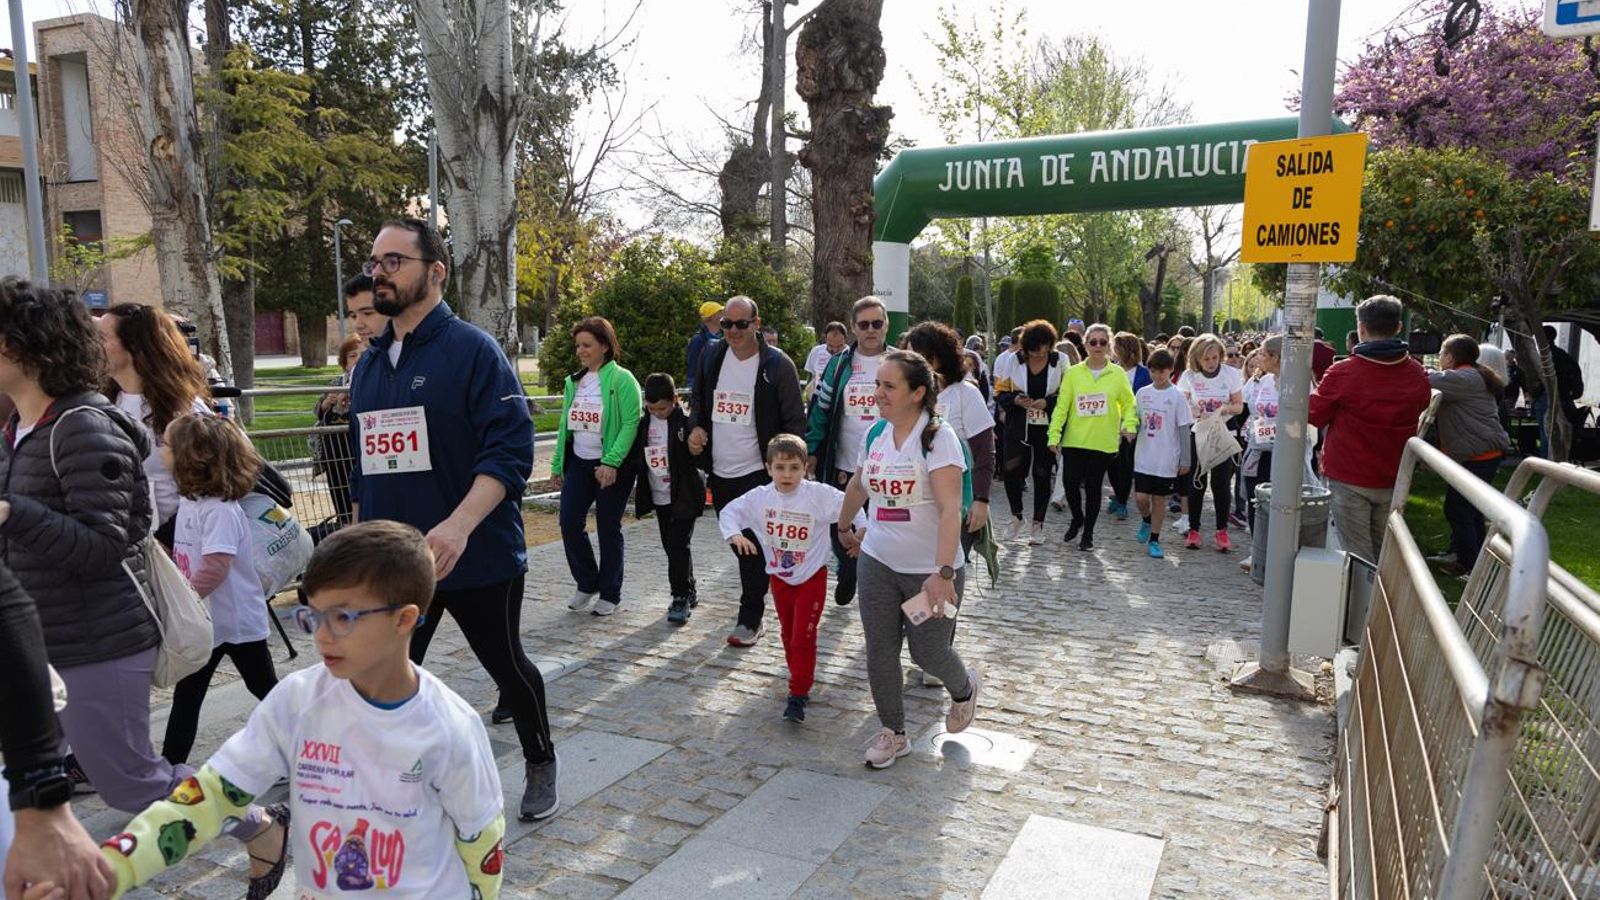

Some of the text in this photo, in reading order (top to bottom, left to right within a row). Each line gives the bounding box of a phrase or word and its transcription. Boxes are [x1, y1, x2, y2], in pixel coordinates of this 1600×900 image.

[938, 157, 1025, 192] JUNTA
[1040, 153, 1075, 187] DE
[1276, 149, 1334, 178] SALIDA
[1292, 186, 1313, 210] DE
[1256, 221, 1340, 247] CAMIONES
[717, 401, 749, 416] 5337
[848, 395, 876, 407] 549
[1079, 400, 1105, 410] 5797
[570, 410, 599, 424] 5338
[1028, 410, 1047, 419] 311
[1258, 426, 1276, 437] 581
[365, 430, 418, 456] 5561
[650, 456, 667, 469] 51
[869, 478, 916, 496] 5187
[767, 521, 808, 541] 5186
[300, 740, 342, 764] XXVII
